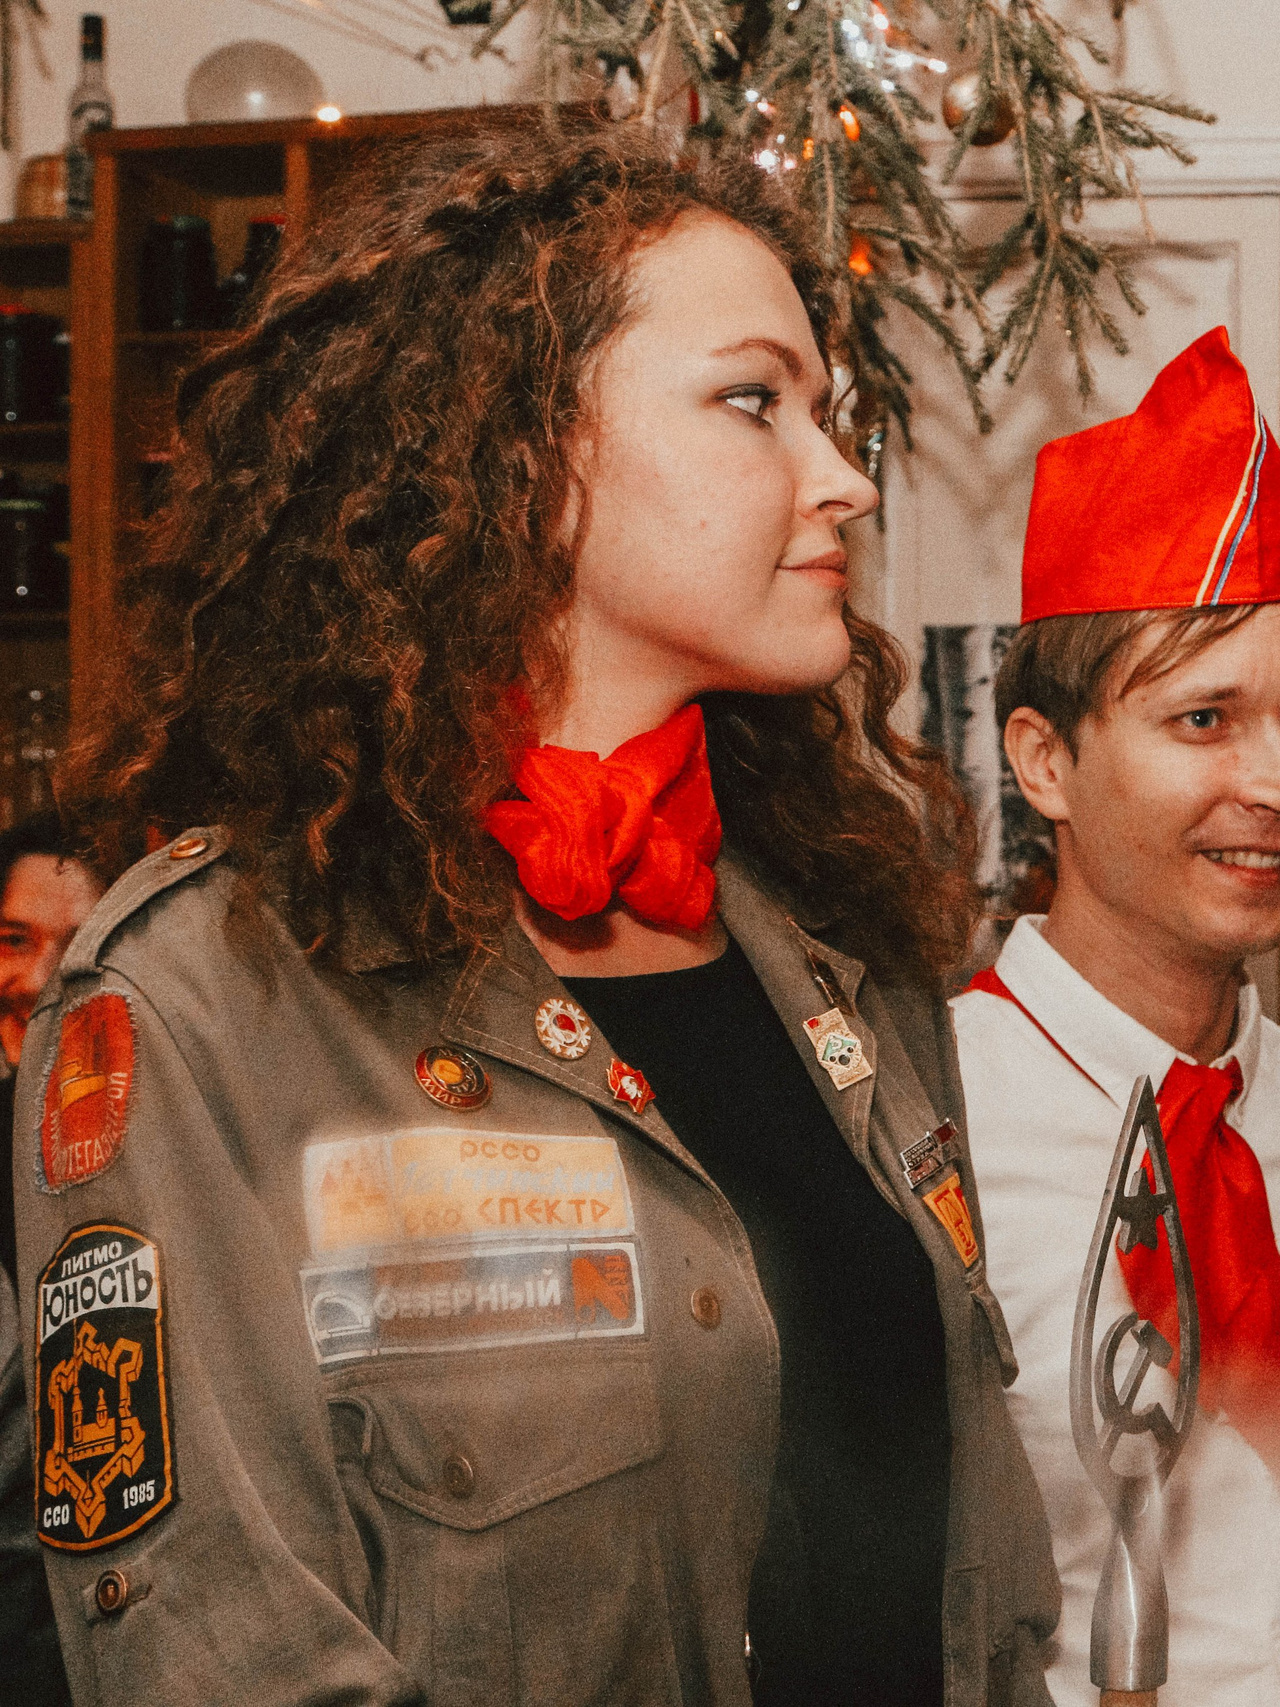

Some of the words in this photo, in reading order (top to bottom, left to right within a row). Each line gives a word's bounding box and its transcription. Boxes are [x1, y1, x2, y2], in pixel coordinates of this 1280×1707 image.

[420, 1078, 462, 1105] МИР
[477, 1197, 612, 1225] СПЕКТР
[61, 1241, 122, 1278] ЛИТМО
[42, 1256, 154, 1339] ЮНОСТЬ
[122, 1479, 156, 1510] 1985
[43, 1503, 70, 1529] ССО
